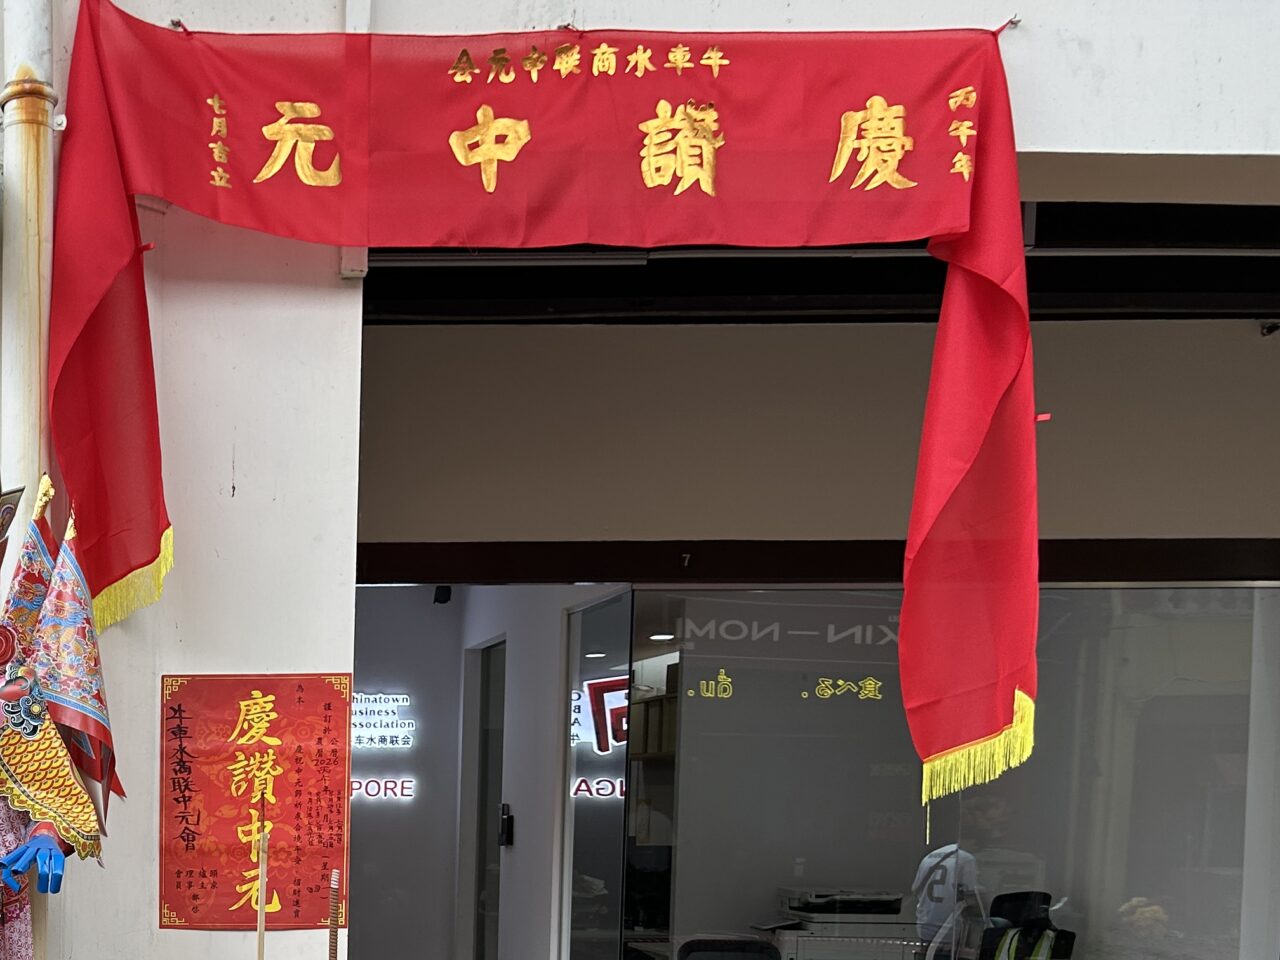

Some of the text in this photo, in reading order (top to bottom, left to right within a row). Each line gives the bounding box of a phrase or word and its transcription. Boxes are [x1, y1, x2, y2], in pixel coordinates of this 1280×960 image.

[253, 95, 919, 197] 慶讚中元
[682, 553, 691, 567] 7
[352, 695, 409, 703] hinatown
[352, 707, 397, 716] usiness
[352, 720, 414, 729] ssociation
[354, 734, 411, 746] 车水商联会
[350, 780, 413, 797] PORE
